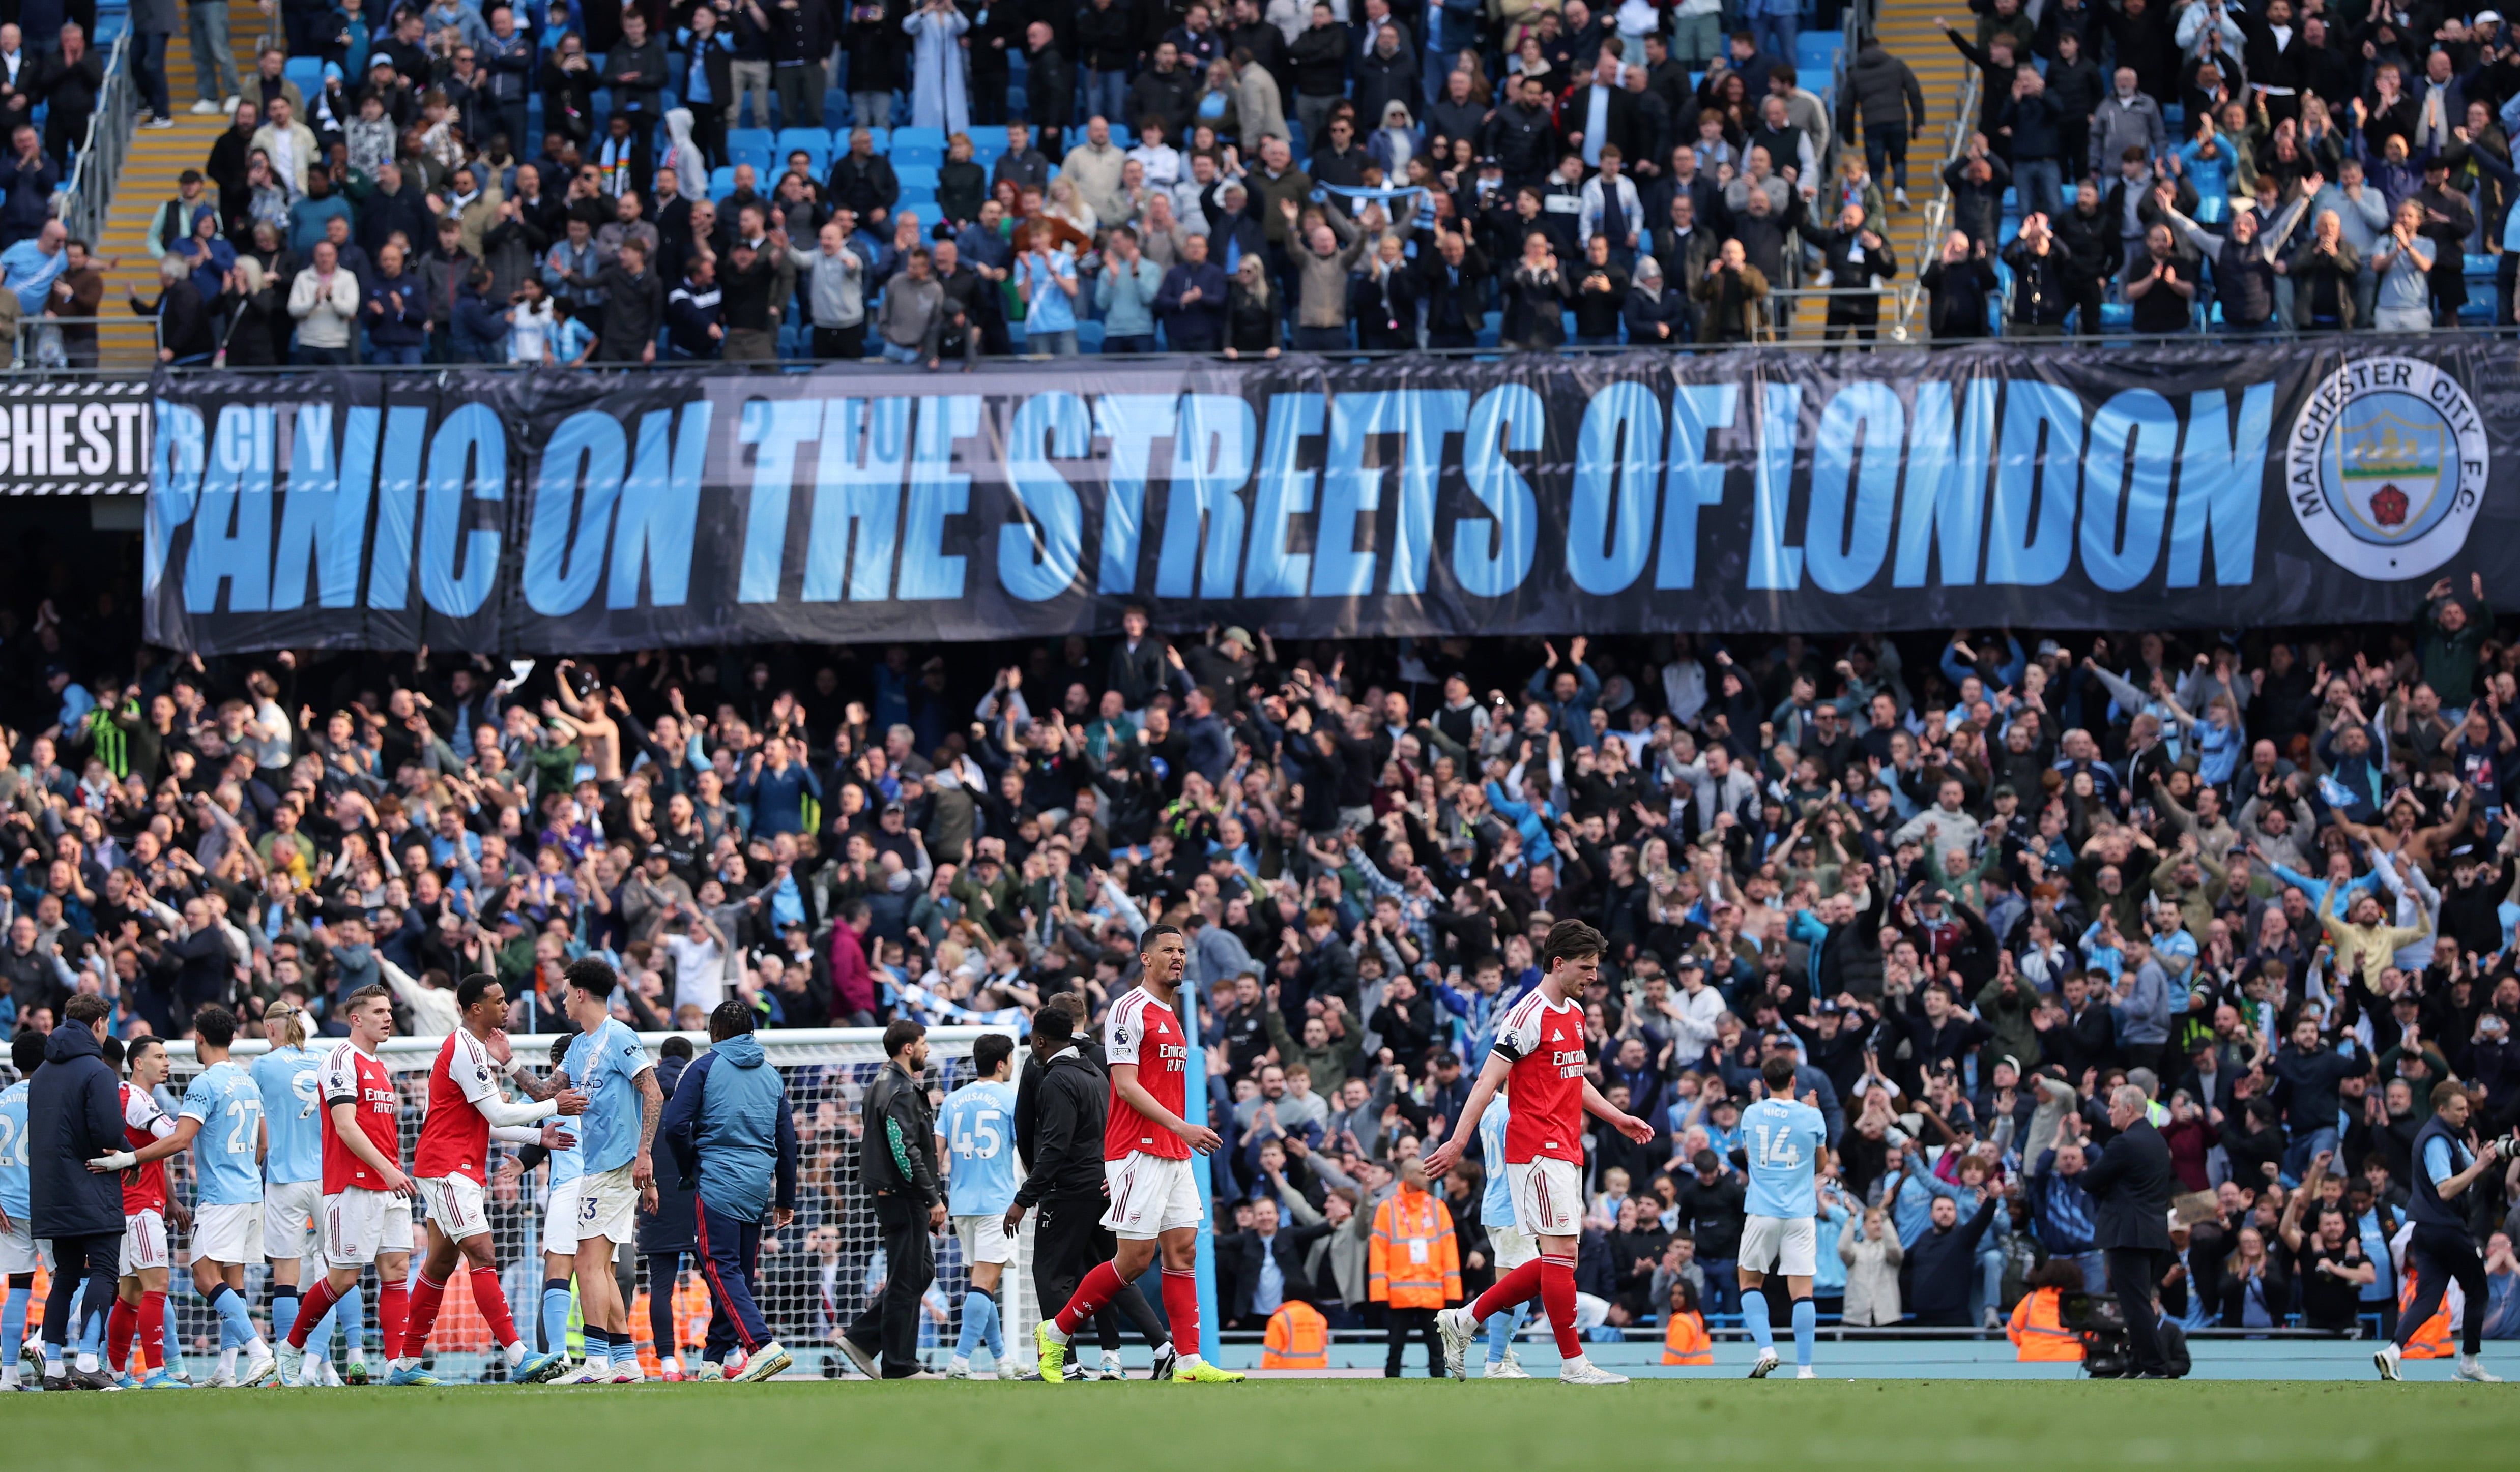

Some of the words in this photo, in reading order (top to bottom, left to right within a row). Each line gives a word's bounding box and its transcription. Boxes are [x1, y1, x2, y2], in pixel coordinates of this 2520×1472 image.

[219, 402, 333, 473] CITY
[2293, 363, 2412, 518] MANCHESTER
[2432, 380, 2478, 434] CITY
[144, 397, 506, 617] PANIC
[524, 400, 713, 617] ON
[738, 395, 981, 603] THE
[998, 382, 1545, 601] STREETS
[1567, 380, 1737, 595] OF
[1746, 378, 2276, 593] LONDON
[281, 1052, 326, 1064] HAALAN
[0, 1093, 28, 1107] SAVIN
[292, 1069, 320, 1119] 9
[951, 1092, 1002, 1109] KHUSANOV
[1763, 1107, 1789, 1118] NICO
[227, 1099, 261, 1153] 27
[951, 1110, 1001, 1160] 45
[1756, 1124, 1800, 1169] 14
